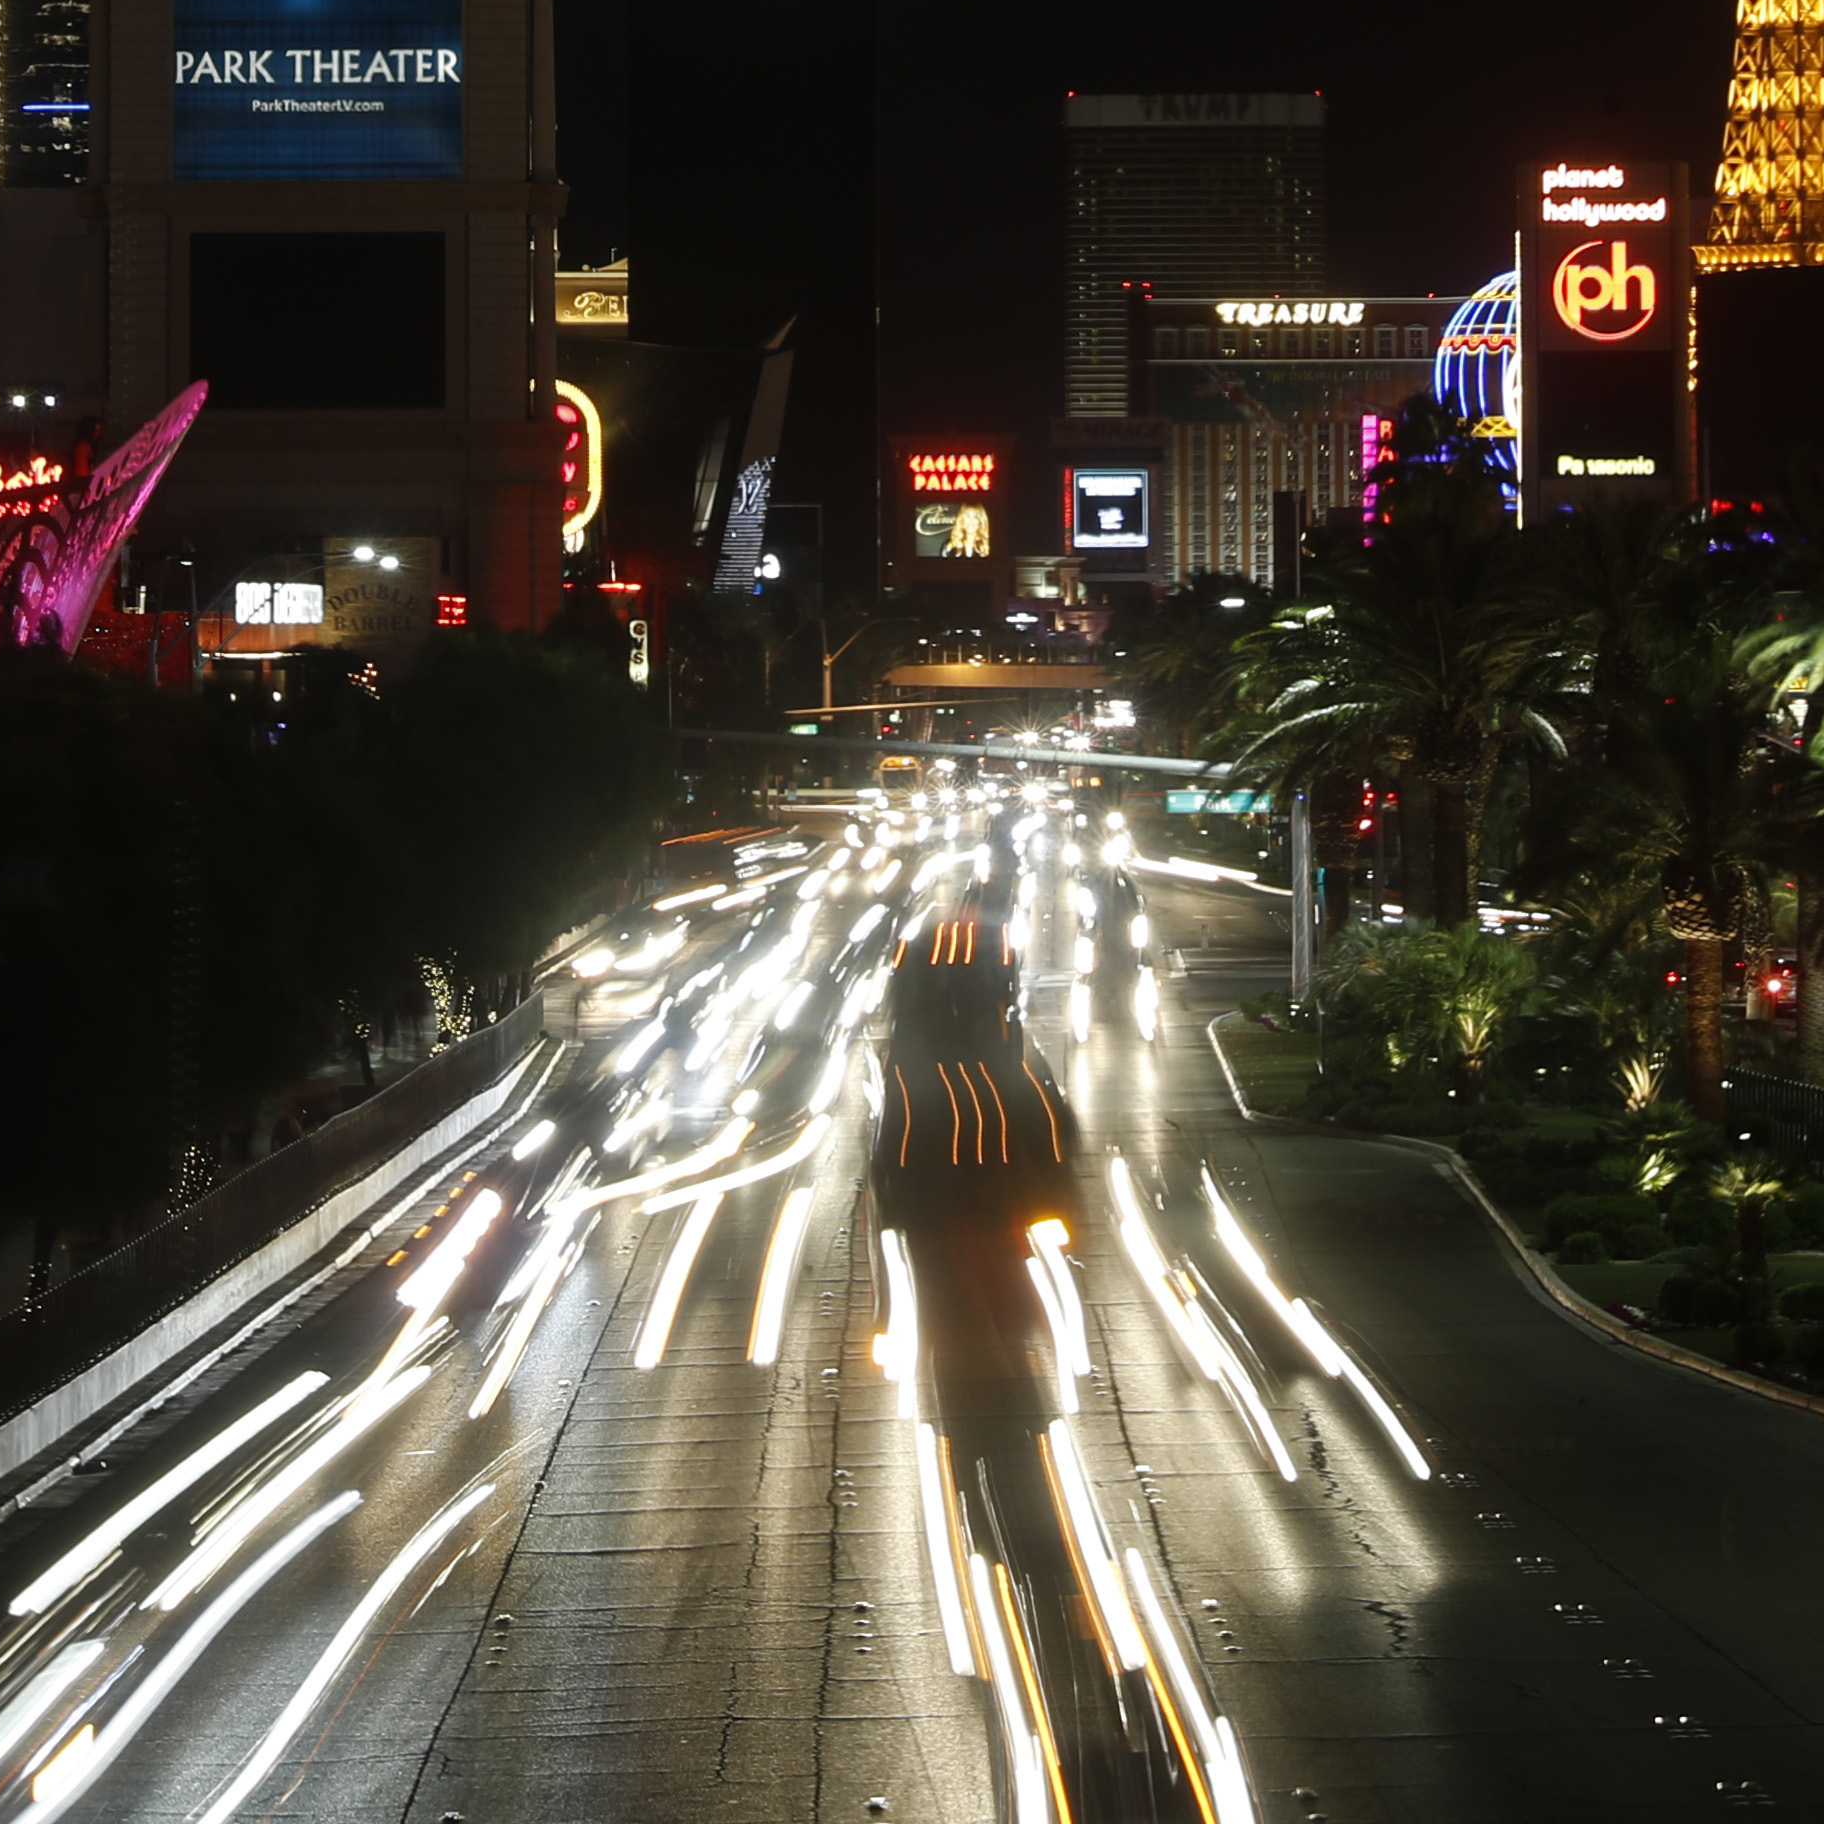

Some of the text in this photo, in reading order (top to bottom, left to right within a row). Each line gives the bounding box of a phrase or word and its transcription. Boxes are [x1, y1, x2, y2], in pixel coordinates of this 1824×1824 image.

[175, 49, 462, 85] PARK THEATER
[251, 98, 385, 115] ParkTheaterLV.com
[1542, 163, 1624, 195] planet
[1542, 197, 1667, 227] hollywood
[1566, 240, 1656, 326] ph
[1216, 302, 1366, 327] TREASURE
[909, 454, 995, 473] CAESARS
[1557, 455, 1655, 475] Panasonic
[914, 473, 990, 490] PALACE
[327, 584, 419, 613] DOUBLE
